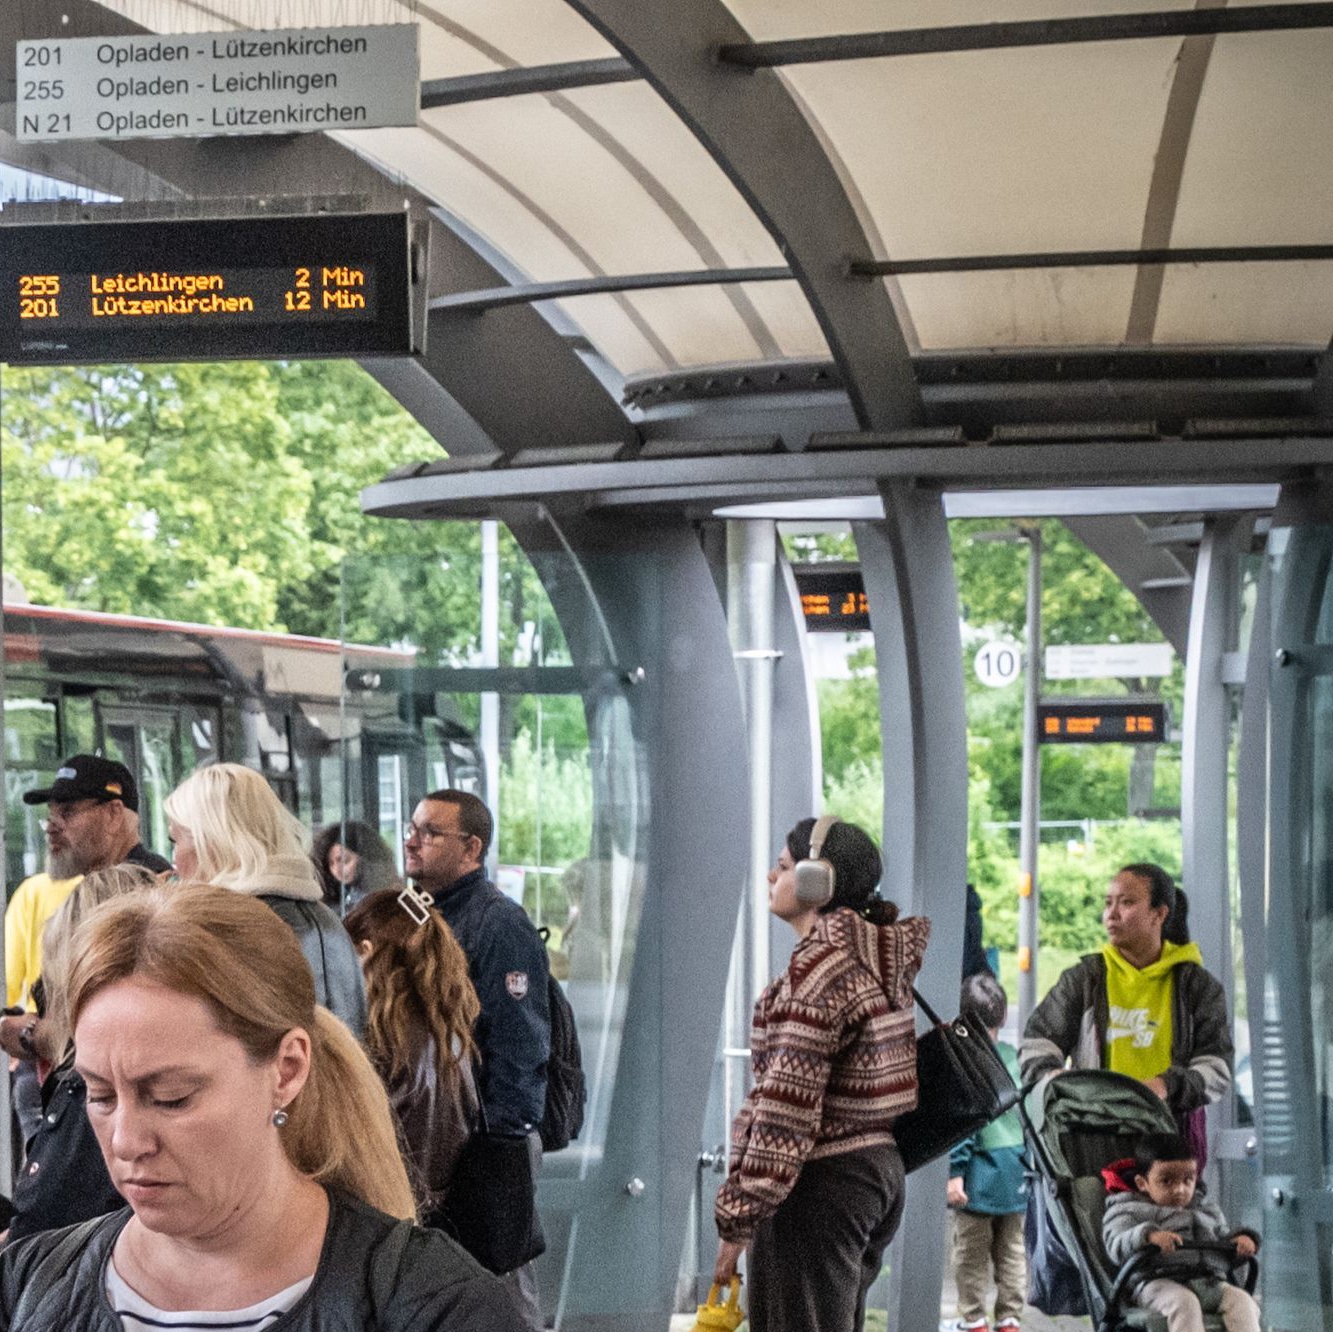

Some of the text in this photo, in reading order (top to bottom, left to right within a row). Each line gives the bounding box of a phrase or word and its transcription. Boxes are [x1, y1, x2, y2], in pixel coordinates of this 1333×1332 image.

[24, 47, 61, 67] 201
[97, 43, 188, 69] Opladen
[212, 35, 367, 59] Lützenkirchen
[24, 80, 64, 100] 255
[97, 76, 189, 102] Opladen
[212, 71, 337, 94] Leichlingen
[23, 115, 39, 134] N
[47, 113, 71, 133] 21
[97, 110, 189, 136] Opladen
[212, 103, 367, 127] Lützenkirchen
[20, 266, 364, 297] 255 Leichlingen 2 Min
[20, 289, 365, 318] 201 Lützenkirchen 12 Min
[981, 649, 1015, 677] 10
